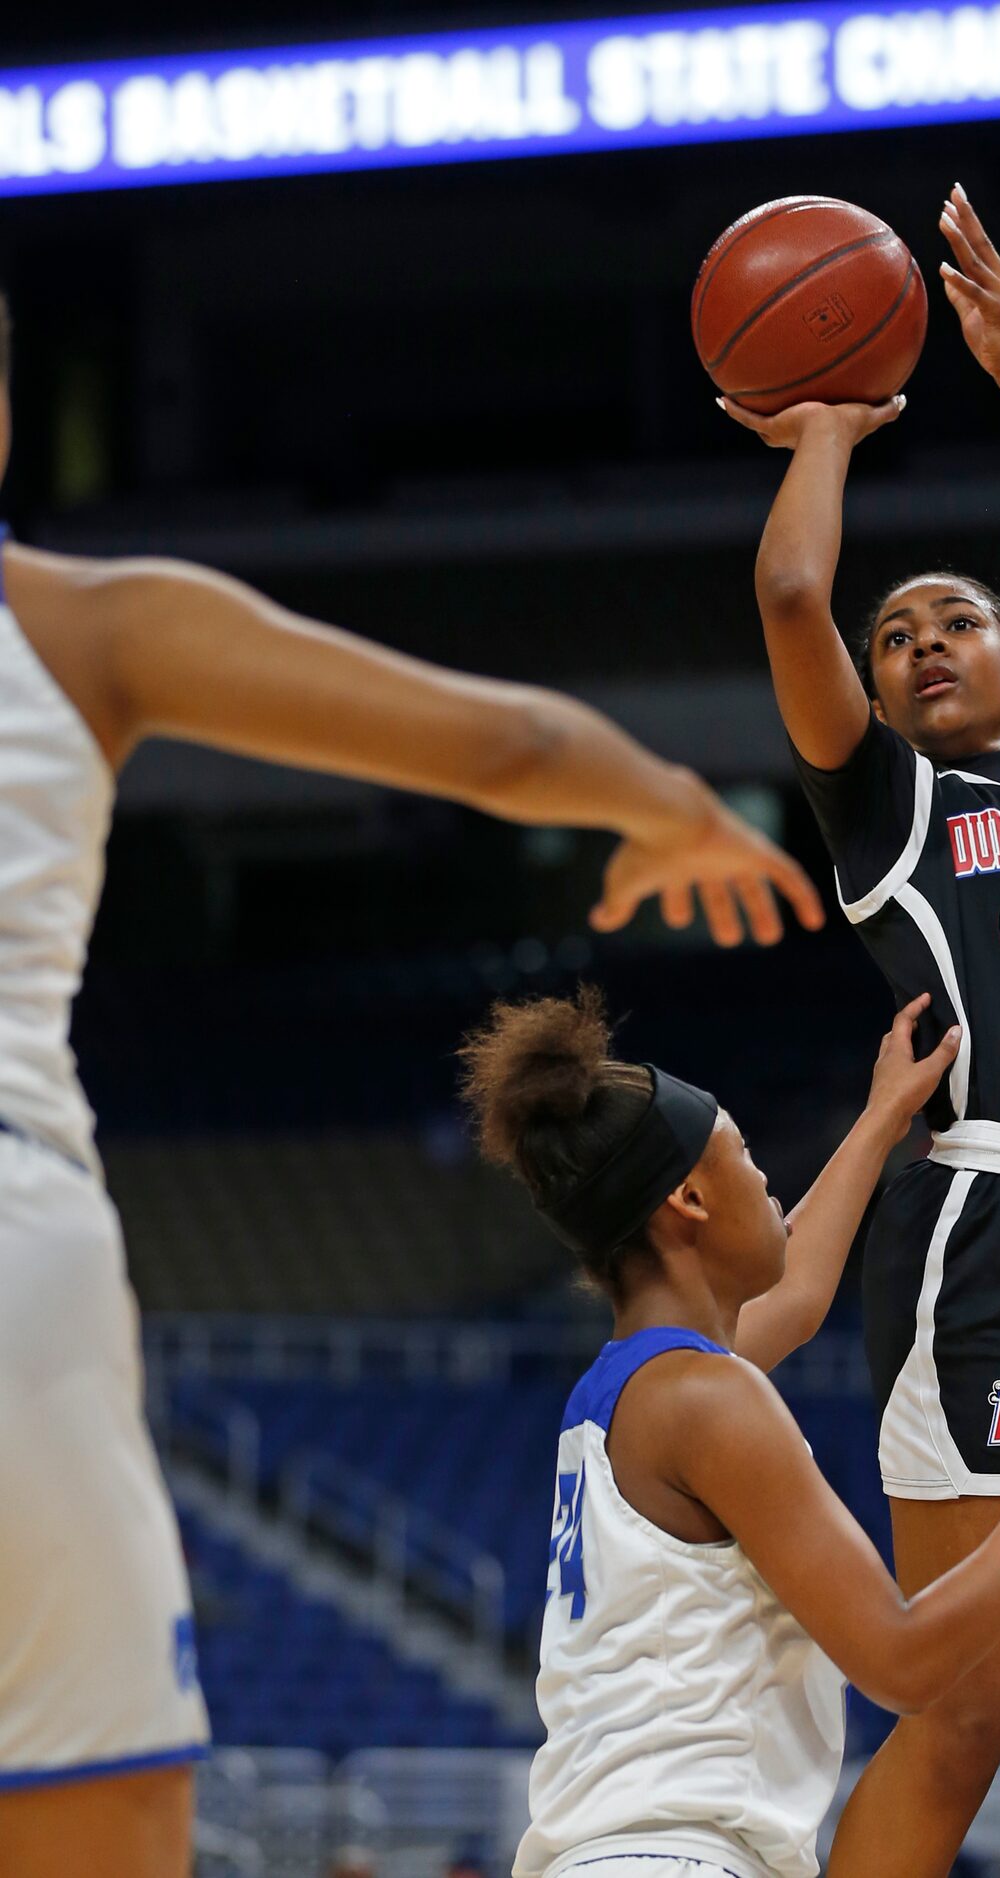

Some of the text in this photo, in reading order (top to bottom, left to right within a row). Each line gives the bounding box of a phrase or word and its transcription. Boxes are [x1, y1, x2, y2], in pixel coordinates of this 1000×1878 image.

[0, 82, 106, 178] LS
[113, 45, 579, 169] BASKETBALL
[588, 20, 828, 129] STATE
